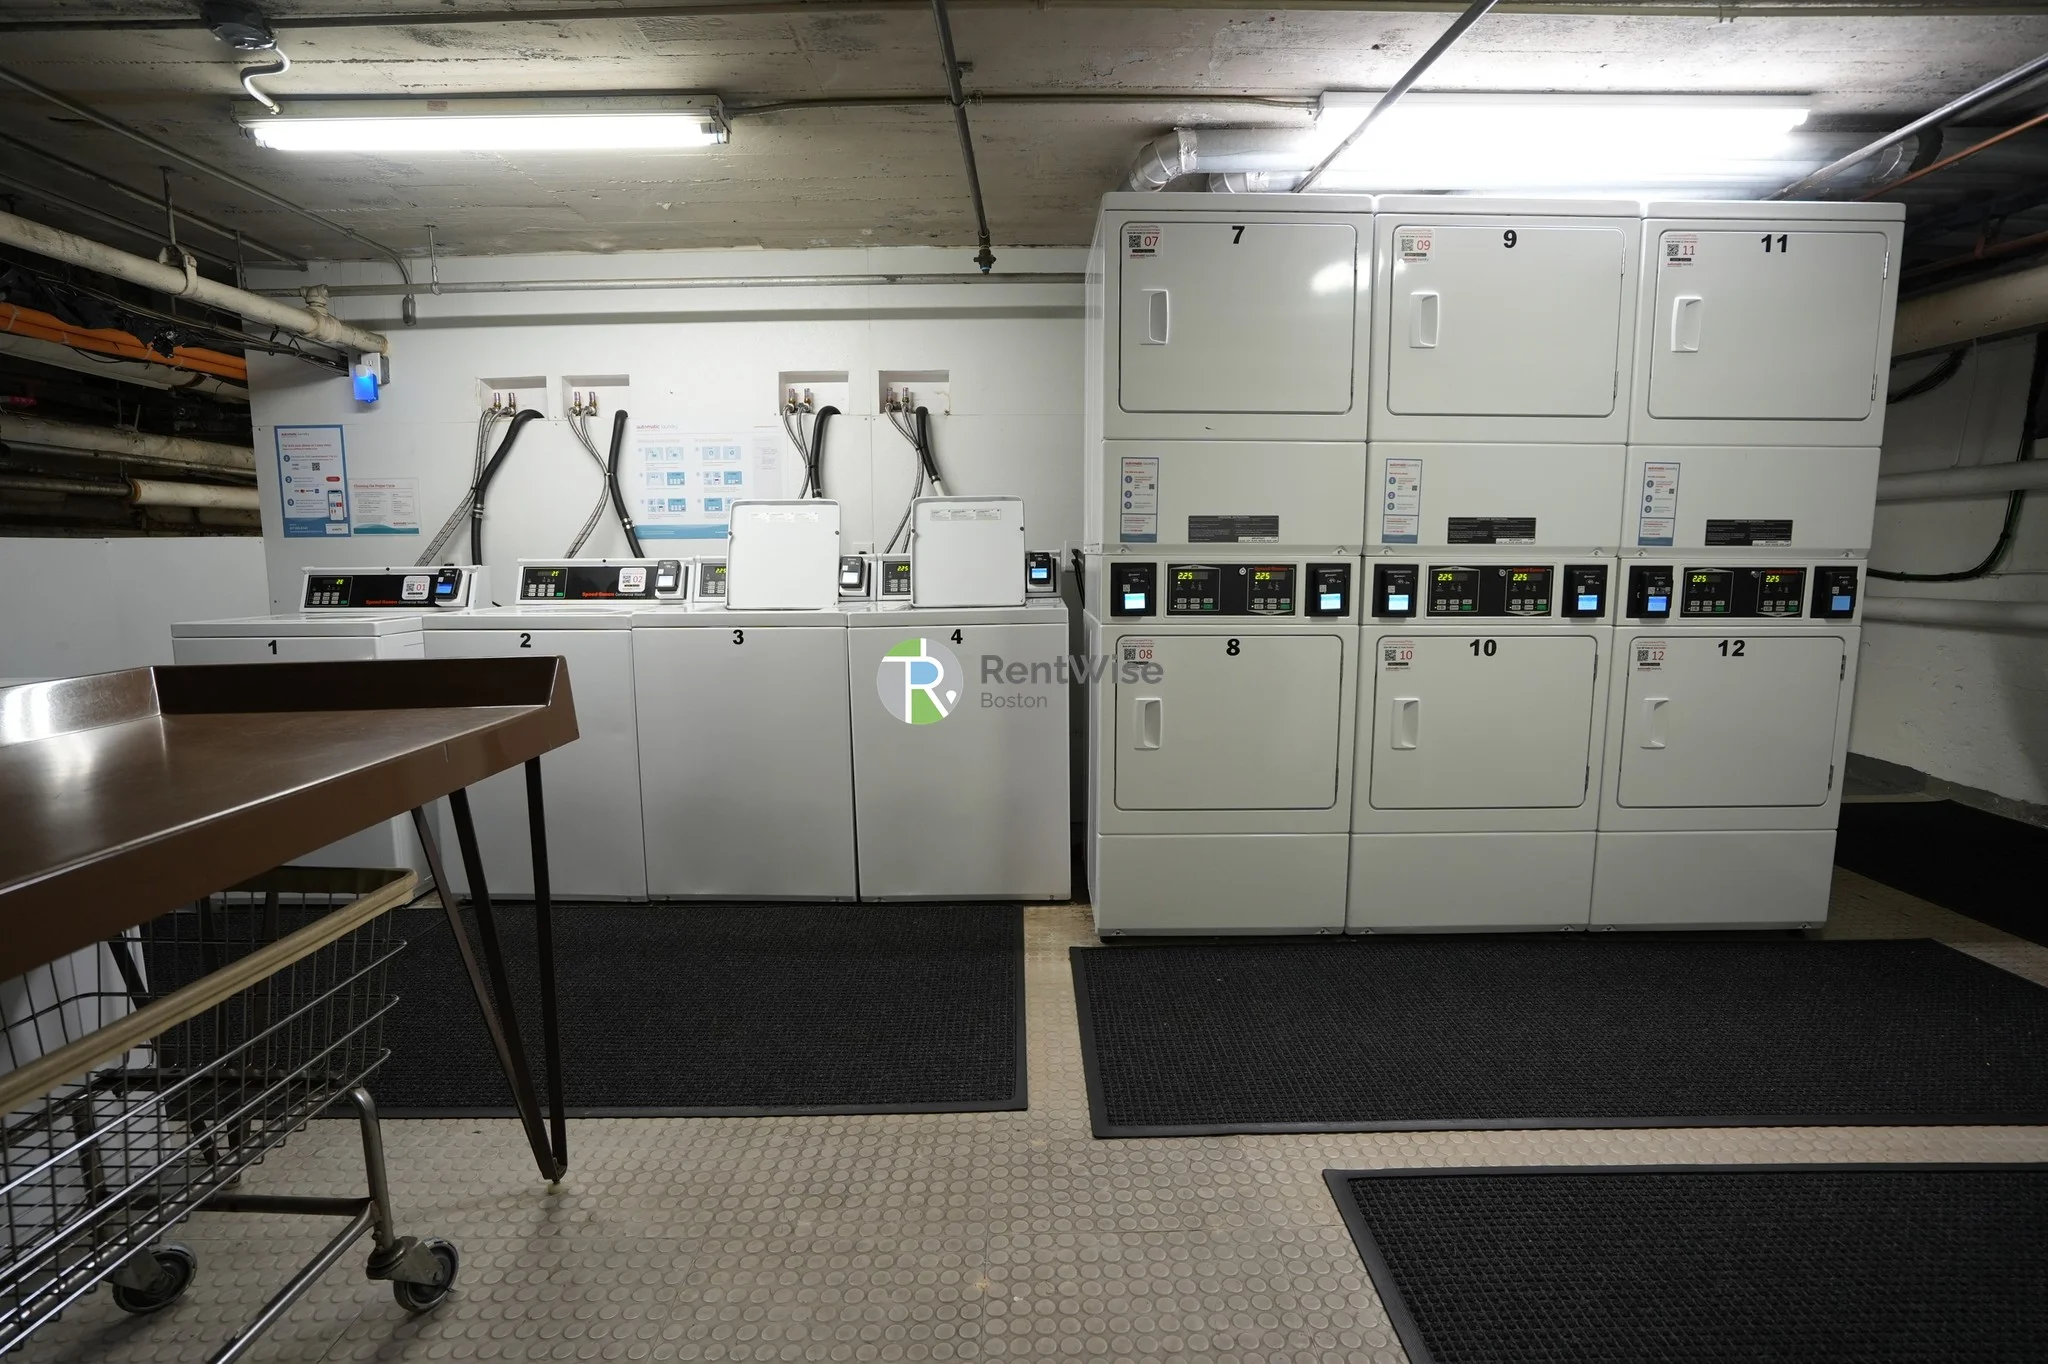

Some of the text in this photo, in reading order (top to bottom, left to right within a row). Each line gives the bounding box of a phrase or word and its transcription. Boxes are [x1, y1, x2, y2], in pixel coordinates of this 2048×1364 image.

[1144, 236, 1159, 247] 07
[1231, 226, 1246, 245] 7
[1503, 229, 1518, 249] 9
[1761, 234, 1788, 253] 11
[1416, 240, 1431, 251] 09
[1682, 245, 1696, 256] 11
[632, 575, 643, 583] 02
[416, 583, 426, 592] 01
[519, 632, 532, 649] 2
[732, 629, 745, 645] 3
[950, 628, 964, 645] 4
[267, 639, 278, 655] 1
[1139, 649, 1153, 659] 08
[1226, 638, 1241, 657] 8
[1469, 638, 1497, 657] 10
[1718, 639, 1746, 657] 12
[1400, 650, 1413, 661] 10
[1652, 651, 1665, 661] 12
